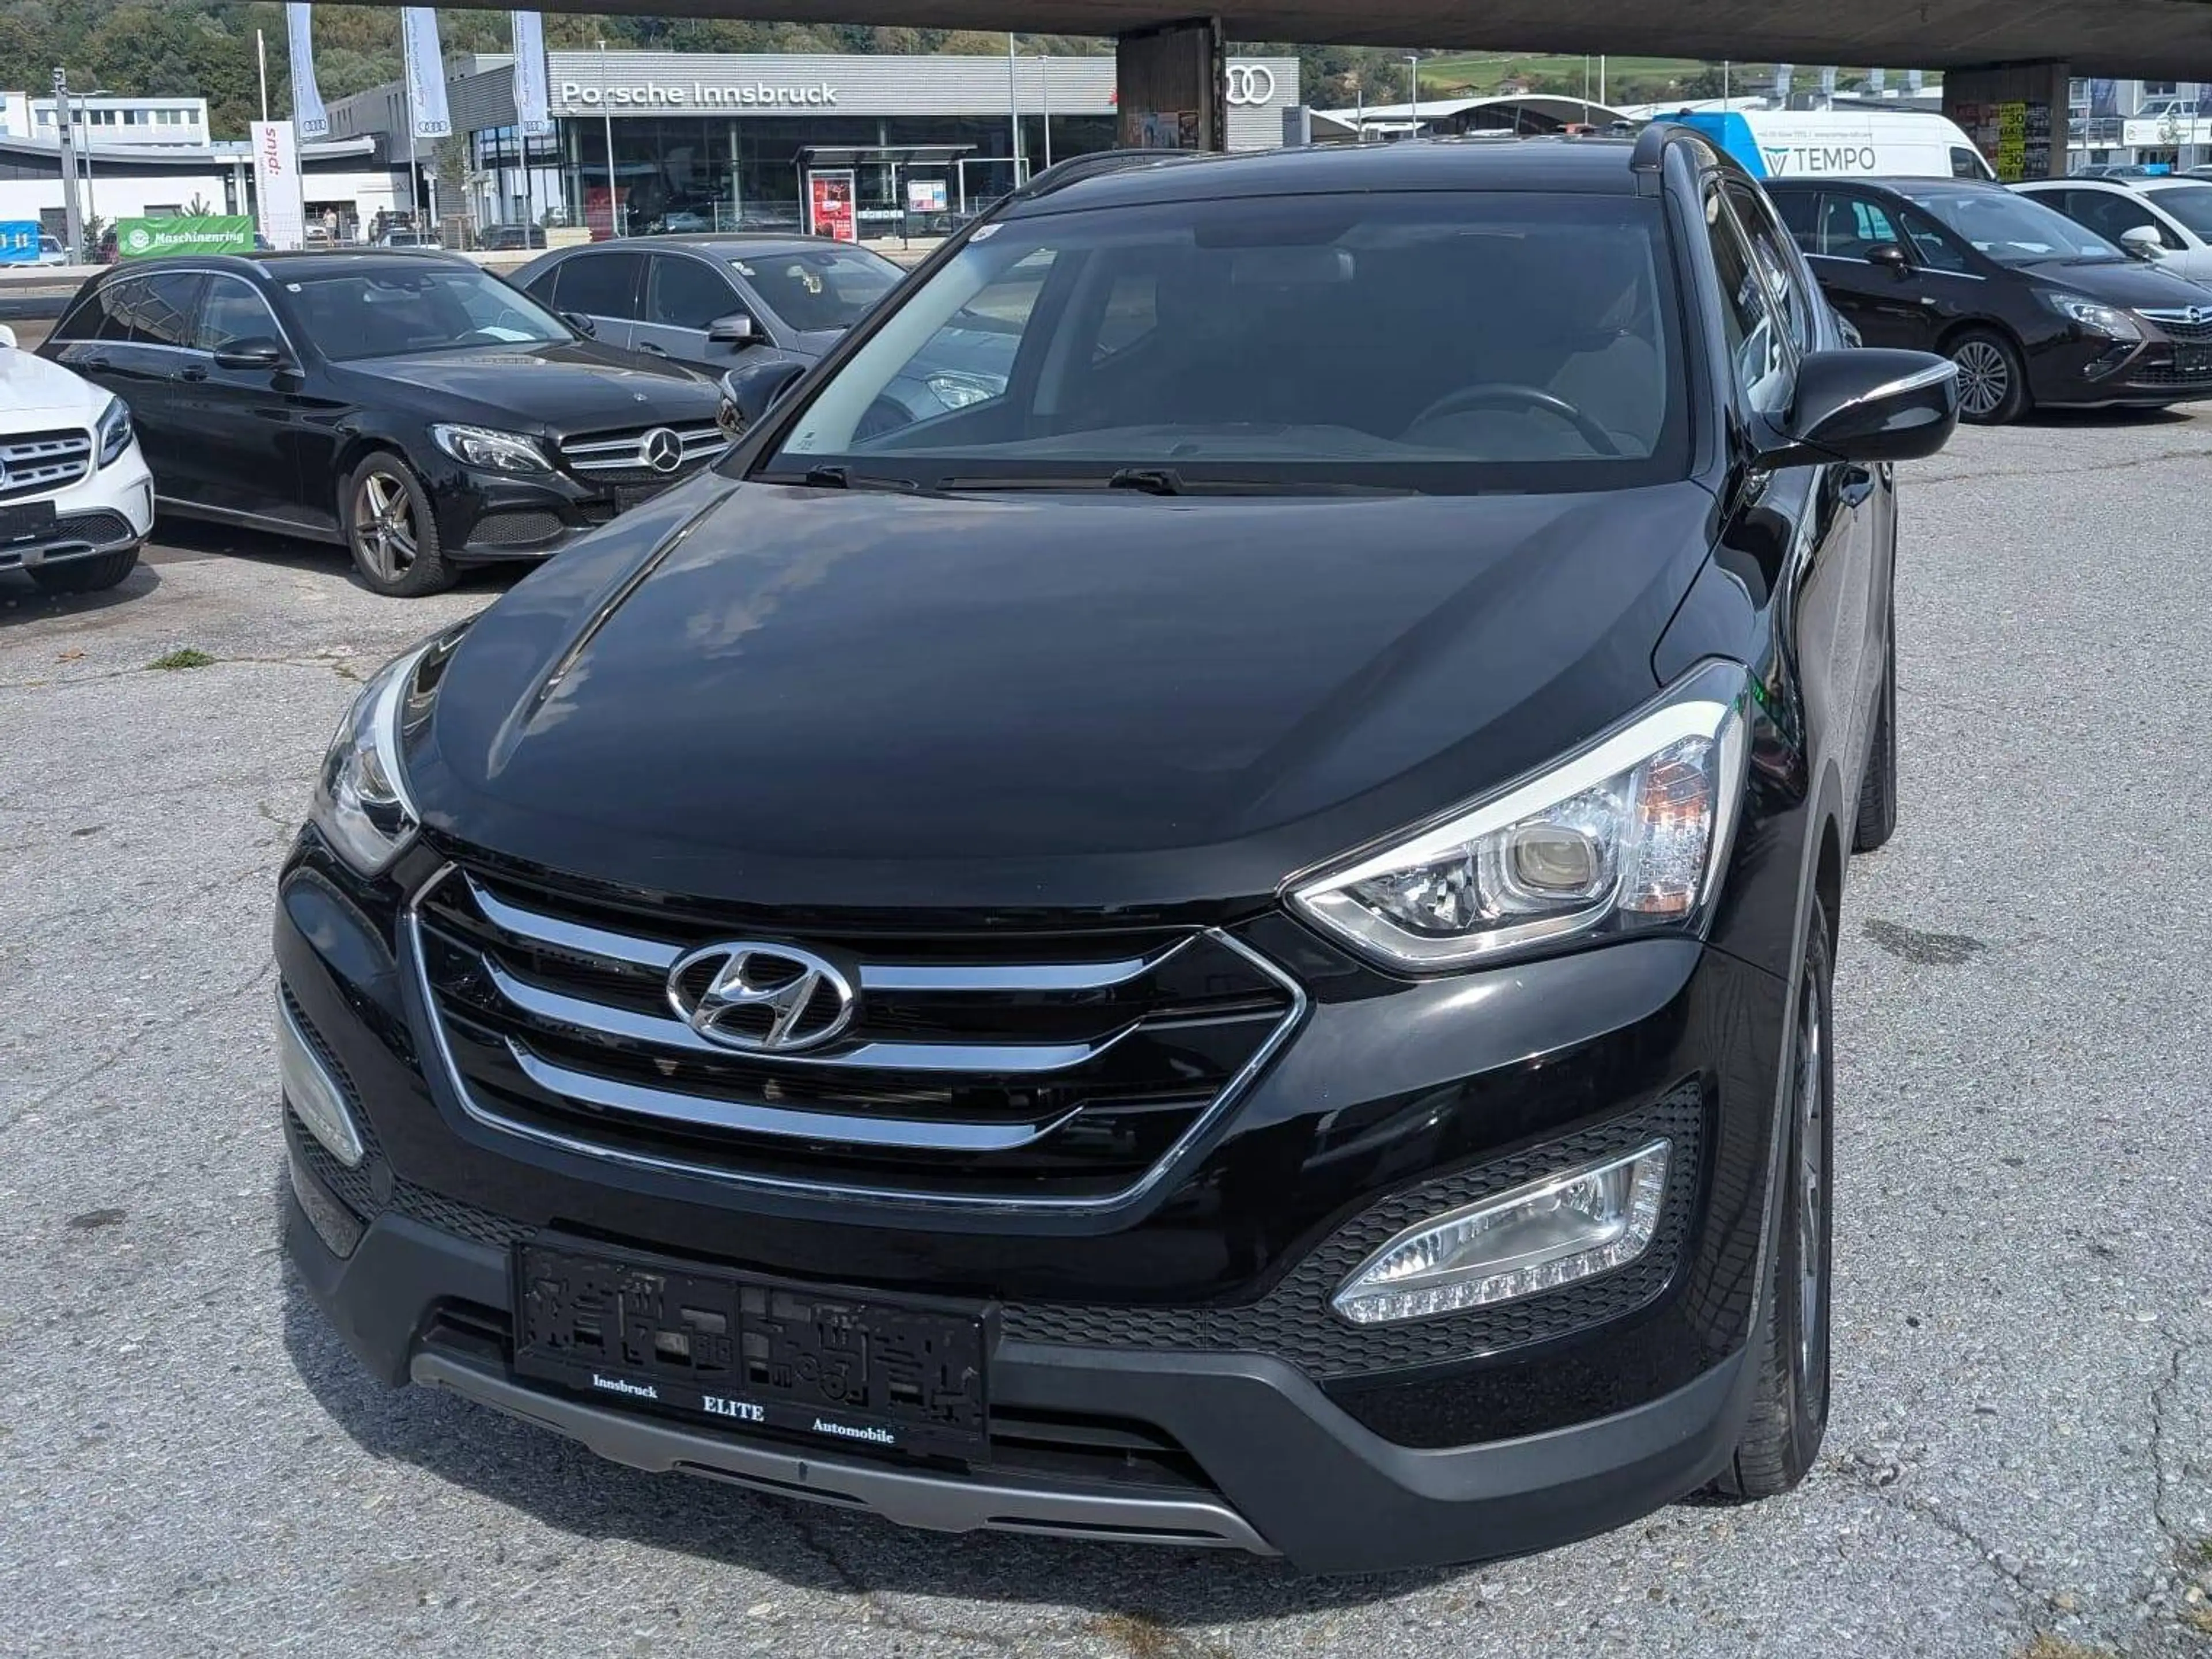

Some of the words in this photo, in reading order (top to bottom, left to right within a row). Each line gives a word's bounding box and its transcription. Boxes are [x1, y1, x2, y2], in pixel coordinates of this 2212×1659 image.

[562, 82, 685, 104] Porsche
[694, 82, 837, 104] Innsbruck
[1793, 147, 1876, 171] TEMPO
[154, 230, 244, 244] Maschinenring
[592, 1373, 658, 1399] Innsbruck
[702, 1395, 765, 1422] ELITE
[811, 1418, 895, 1444] Automobile
